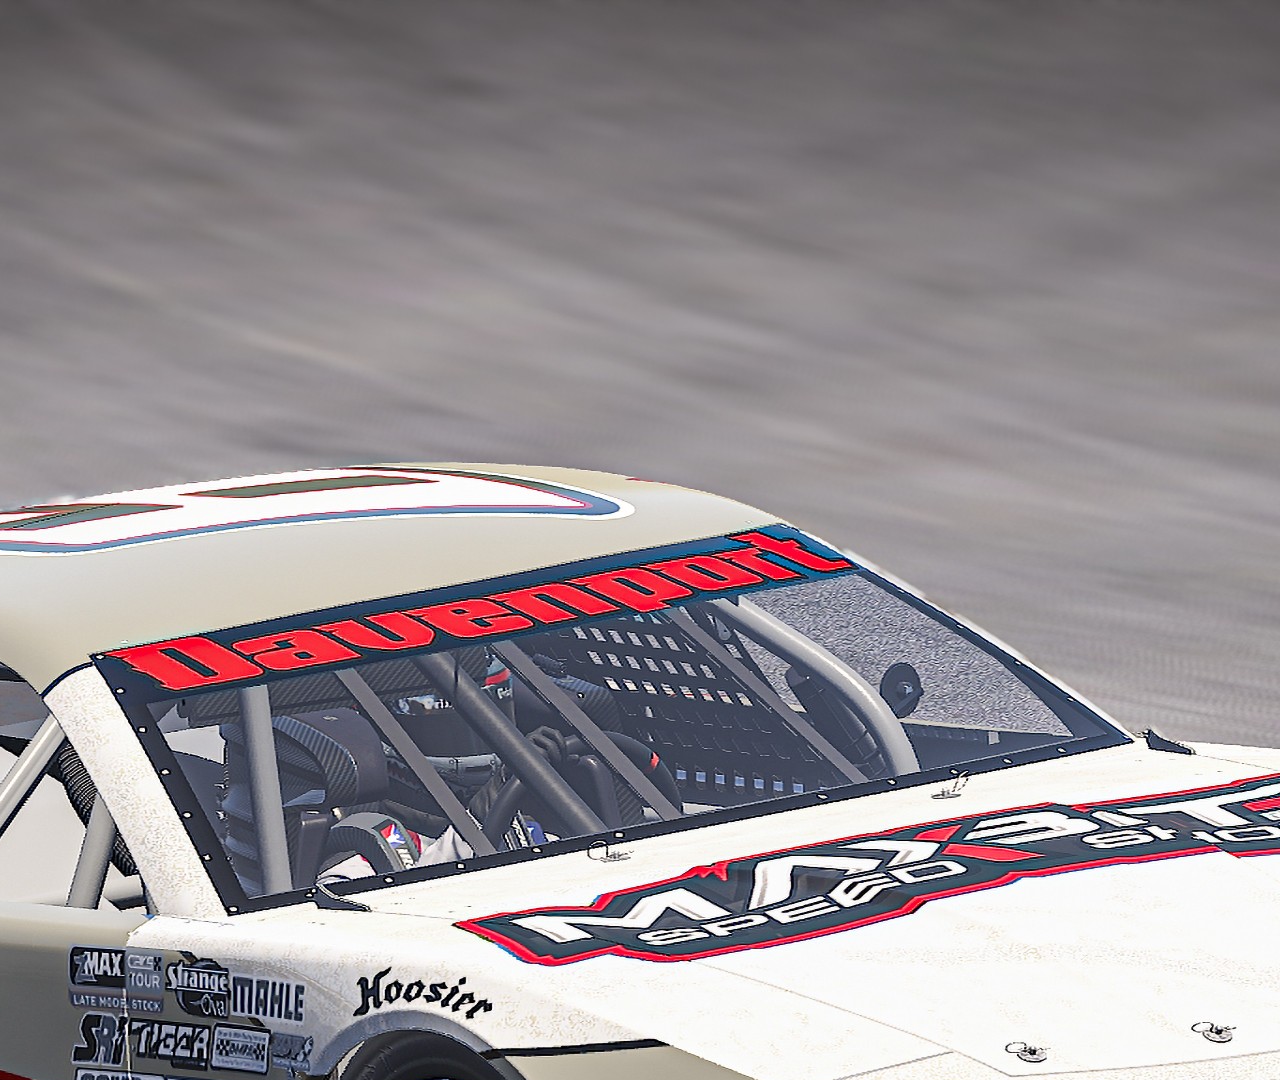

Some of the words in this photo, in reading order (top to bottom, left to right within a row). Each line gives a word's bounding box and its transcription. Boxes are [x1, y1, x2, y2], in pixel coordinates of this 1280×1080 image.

[119, 530, 855, 692] Davenport
[637, 860, 967, 946] SPEED
[129, 971, 160, 988] TOUR
[166, 960, 229, 991] Strange
[232, 975, 305, 1021] MAHLE
[353, 966, 493, 1020] Hoosier
[73, 994, 97, 1006] LATE
